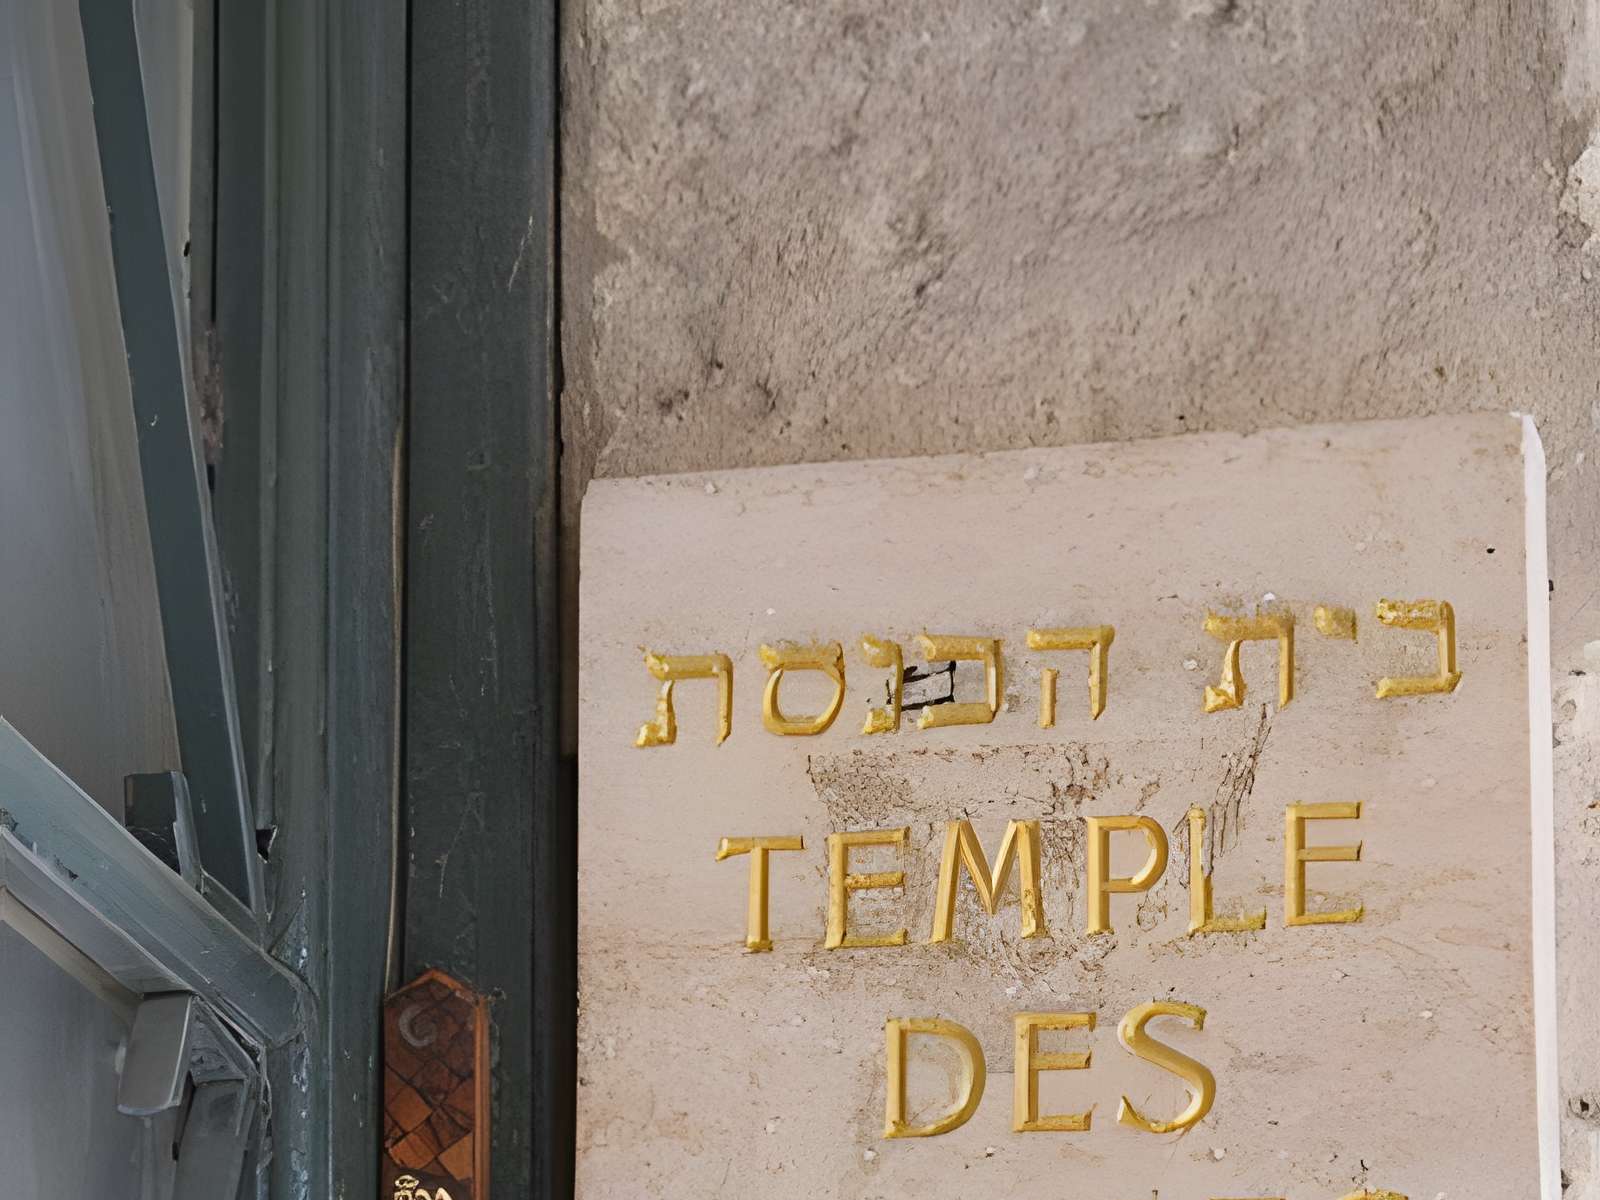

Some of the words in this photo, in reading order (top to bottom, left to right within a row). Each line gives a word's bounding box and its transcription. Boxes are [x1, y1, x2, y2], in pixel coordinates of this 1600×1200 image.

[633, 624, 1115, 748] הכנסת
[1203, 598, 1463, 713] בית
[715, 801, 1364, 953] TEMPLE
[883, 1001, 1216, 1139] DES
